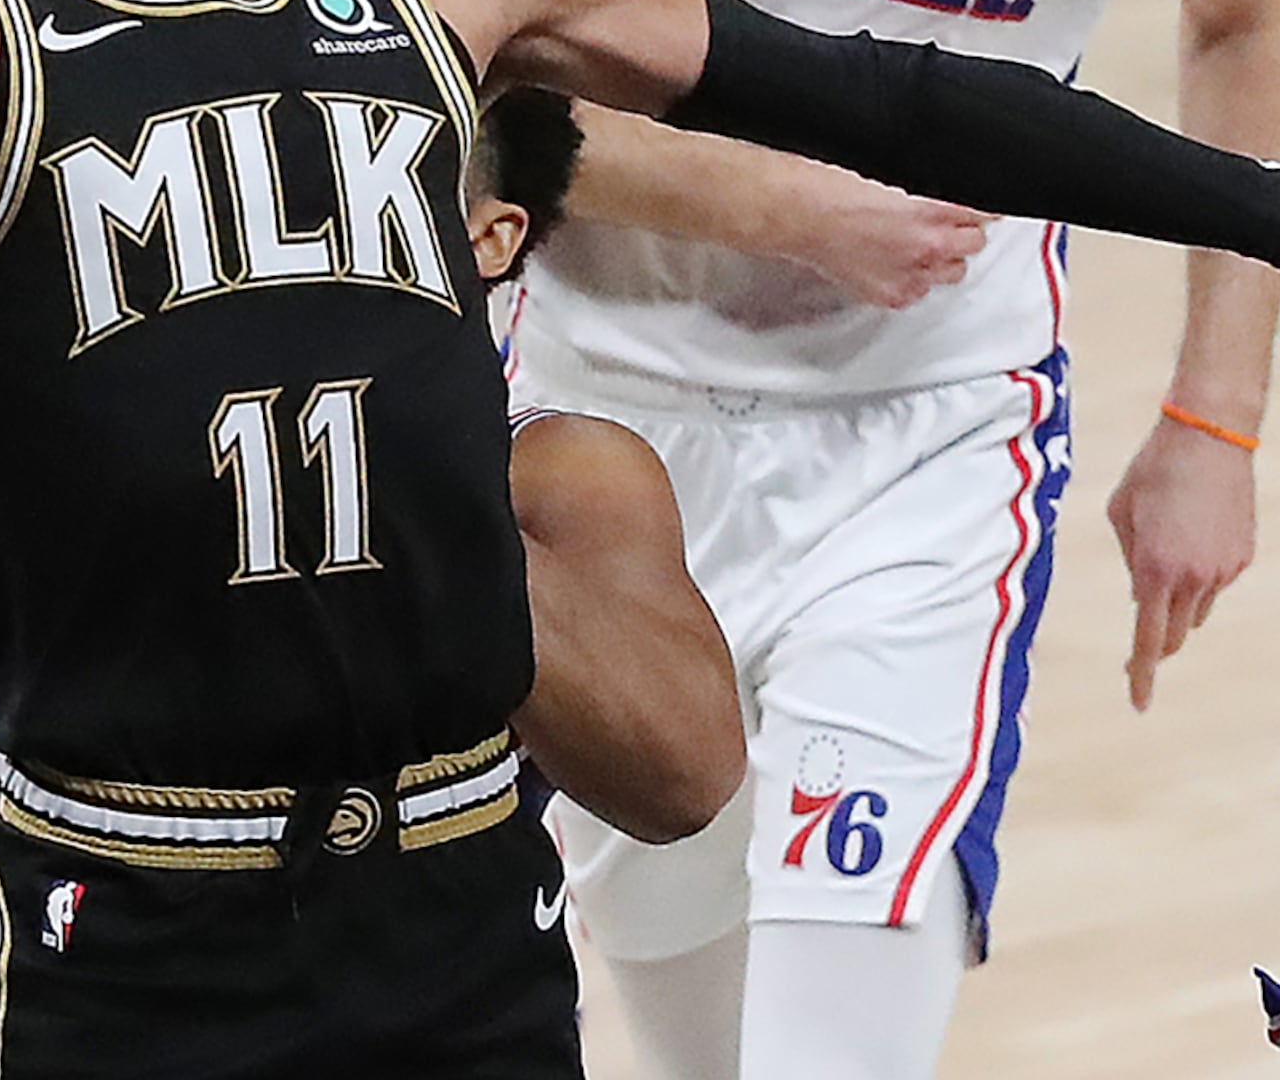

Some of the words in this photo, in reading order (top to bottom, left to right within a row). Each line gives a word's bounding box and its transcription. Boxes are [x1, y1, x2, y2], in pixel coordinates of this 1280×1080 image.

[312, 34, 411, 55] sharecare
[39, 91, 463, 360] MLK
[208, 377, 384, 585] 11
[782, 780, 888, 877] 76
